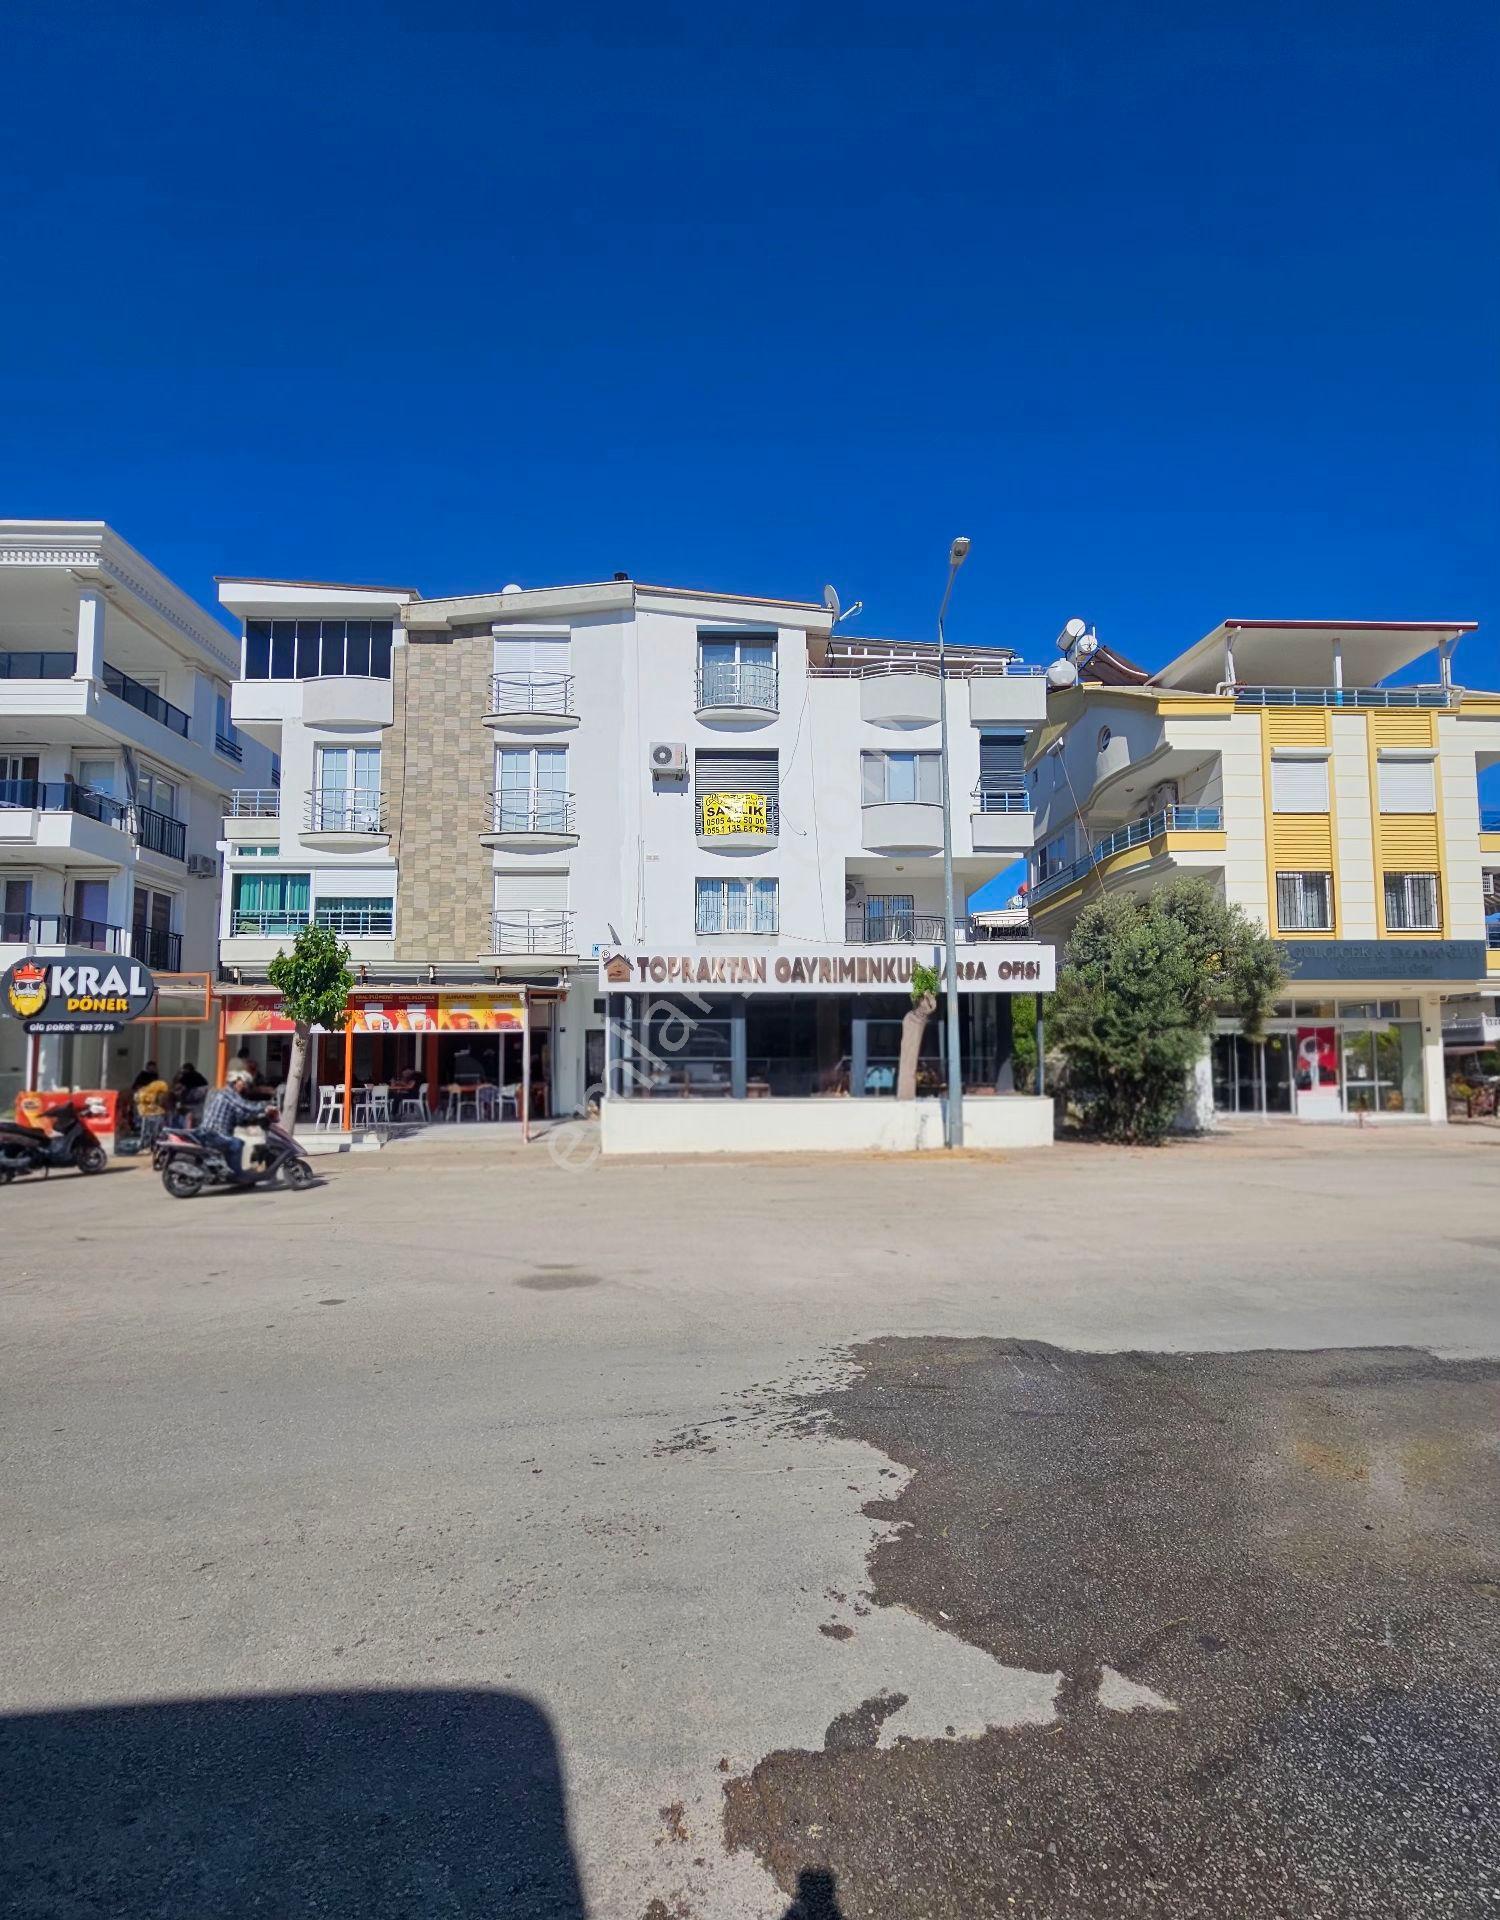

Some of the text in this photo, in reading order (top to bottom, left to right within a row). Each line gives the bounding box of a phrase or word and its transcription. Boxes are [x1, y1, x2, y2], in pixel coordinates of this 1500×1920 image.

[51, 965, 147, 997] KRAL
[637, 956, 767, 984] TOPRAKTAN
[67, 995, 129, 1012] DÖNER
